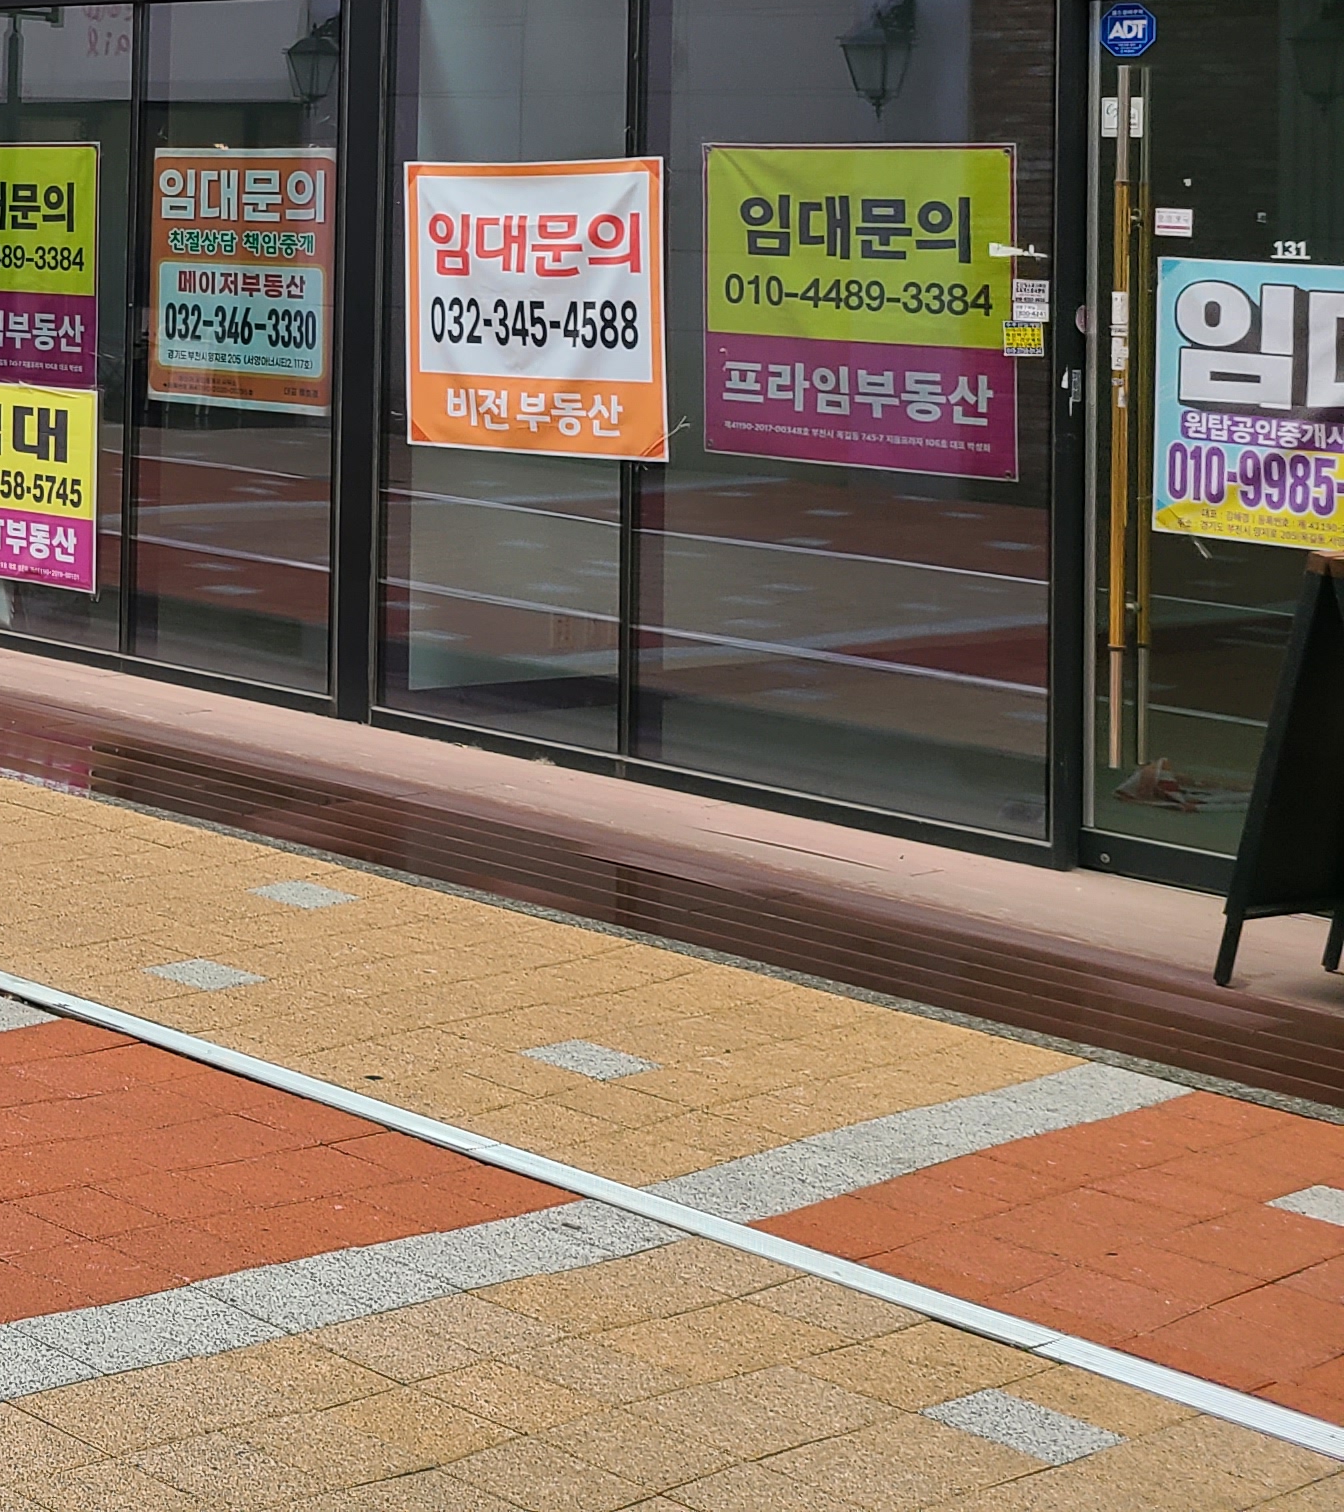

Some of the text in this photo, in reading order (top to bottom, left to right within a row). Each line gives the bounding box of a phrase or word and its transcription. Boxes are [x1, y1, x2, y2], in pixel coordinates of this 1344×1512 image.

[1108, 19, 1148, 40] ADT
[158, 167, 326, 224] 임대문의
[167, 227, 316, 258] 친절상담 책임중개
[426, 212, 643, 278] 임대문의
[739, 194, 972, 264] 임대문의
[1273, 240, 1308, 257] 131
[176, 269, 306, 299] 메이저부동산
[724, 273, 993, 317] 010-4489-3384
[164, 300, 318, 351] 032-346-3330
[430, 296, 640, 350] 032-345-4588
[446, 387, 624, 437] 비전 부동산
[721, 360, 994, 428] 프라임부동산
